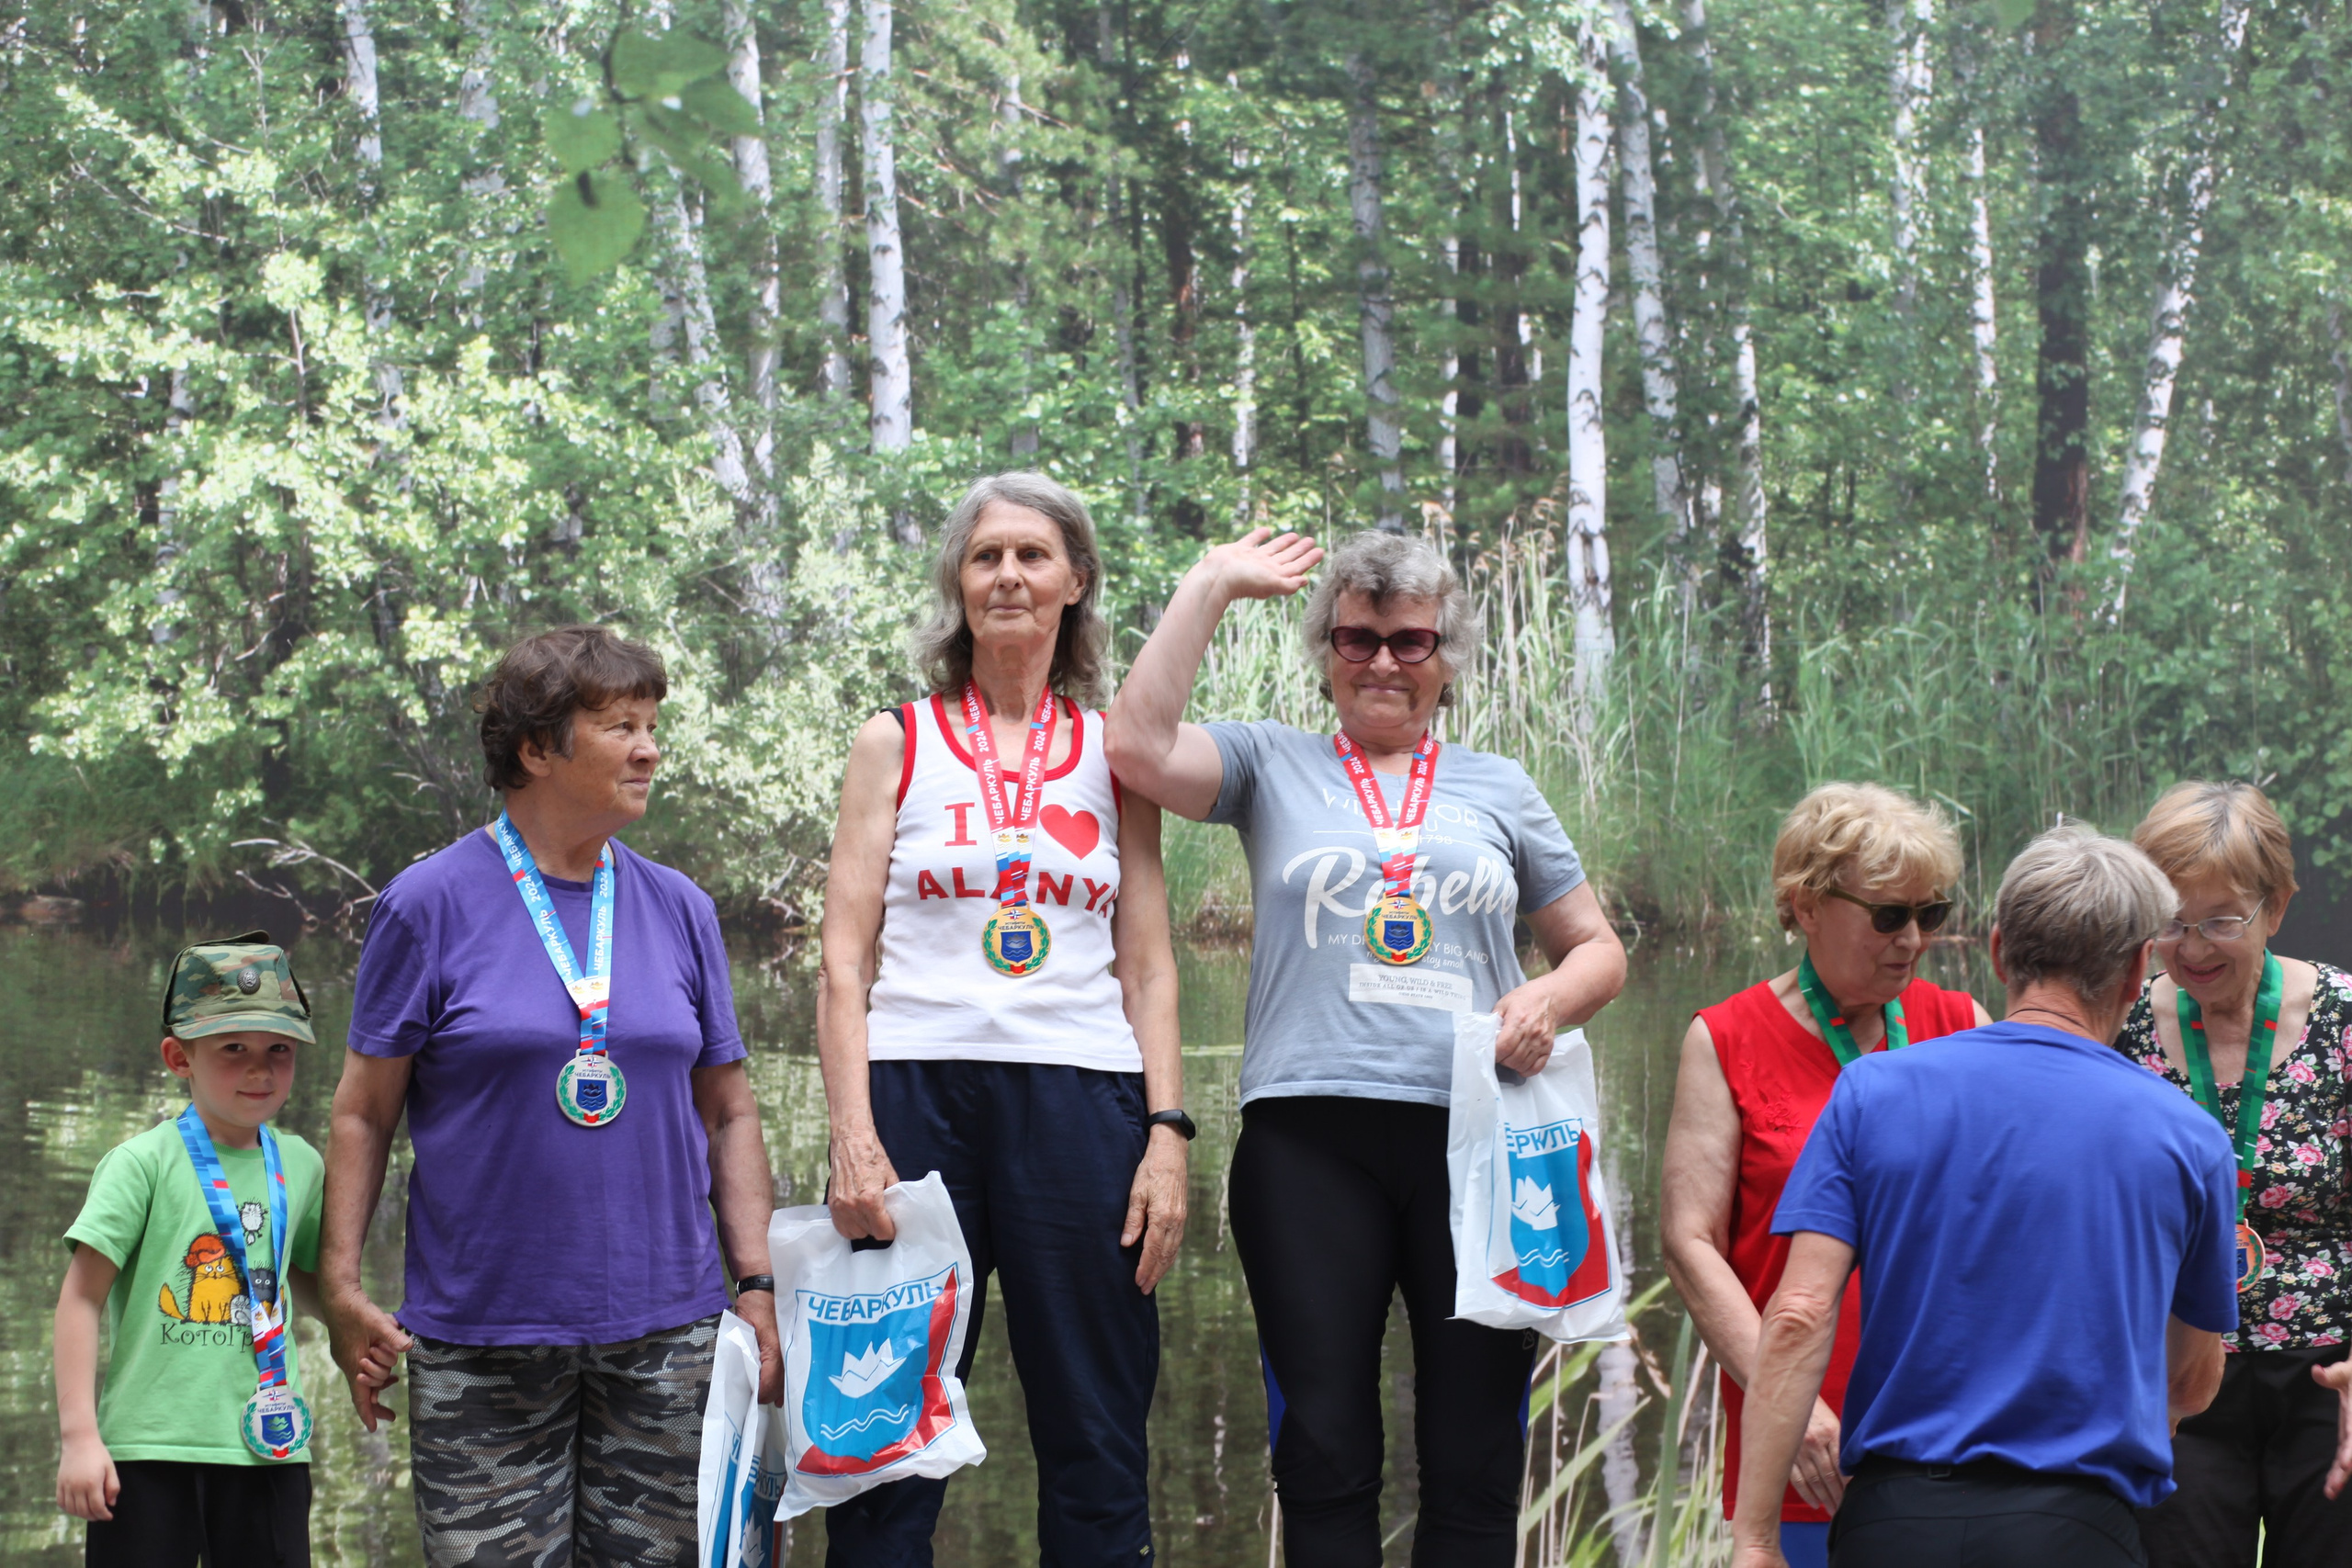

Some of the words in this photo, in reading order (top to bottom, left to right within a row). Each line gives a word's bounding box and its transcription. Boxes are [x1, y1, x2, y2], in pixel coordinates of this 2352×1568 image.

[965, 681, 981, 723] ЧЕБАРКУ
[975, 730, 989, 753] 2024
[1020, 756, 1041, 822] ЧЕБАРКУЛЬ
[1034, 730, 1047, 751] 2024
[1349, 756, 1365, 775] 2024
[983, 758, 1006, 825] ЧЕБАРКУЛЬ
[1360, 778, 1385, 826] ЧЕБАРКУЛЬ
[1405, 777, 1426, 824] ЧЕБАРКУЛЬ
[1417, 761, 1429, 776] 2024
[944, 802, 977, 847] I
[523, 874, 542, 903] 2024
[599, 871, 609, 898] 2024
[538, 908, 572, 976] ЧЕБАРКУЛЬ
[594, 905, 607, 971] ЧЕБАРКУЛЬ
[1328, 933, 1348, 945] MY
[1443, 942, 1463, 957] BIG
[1464, 949, 1489, 964] AND
